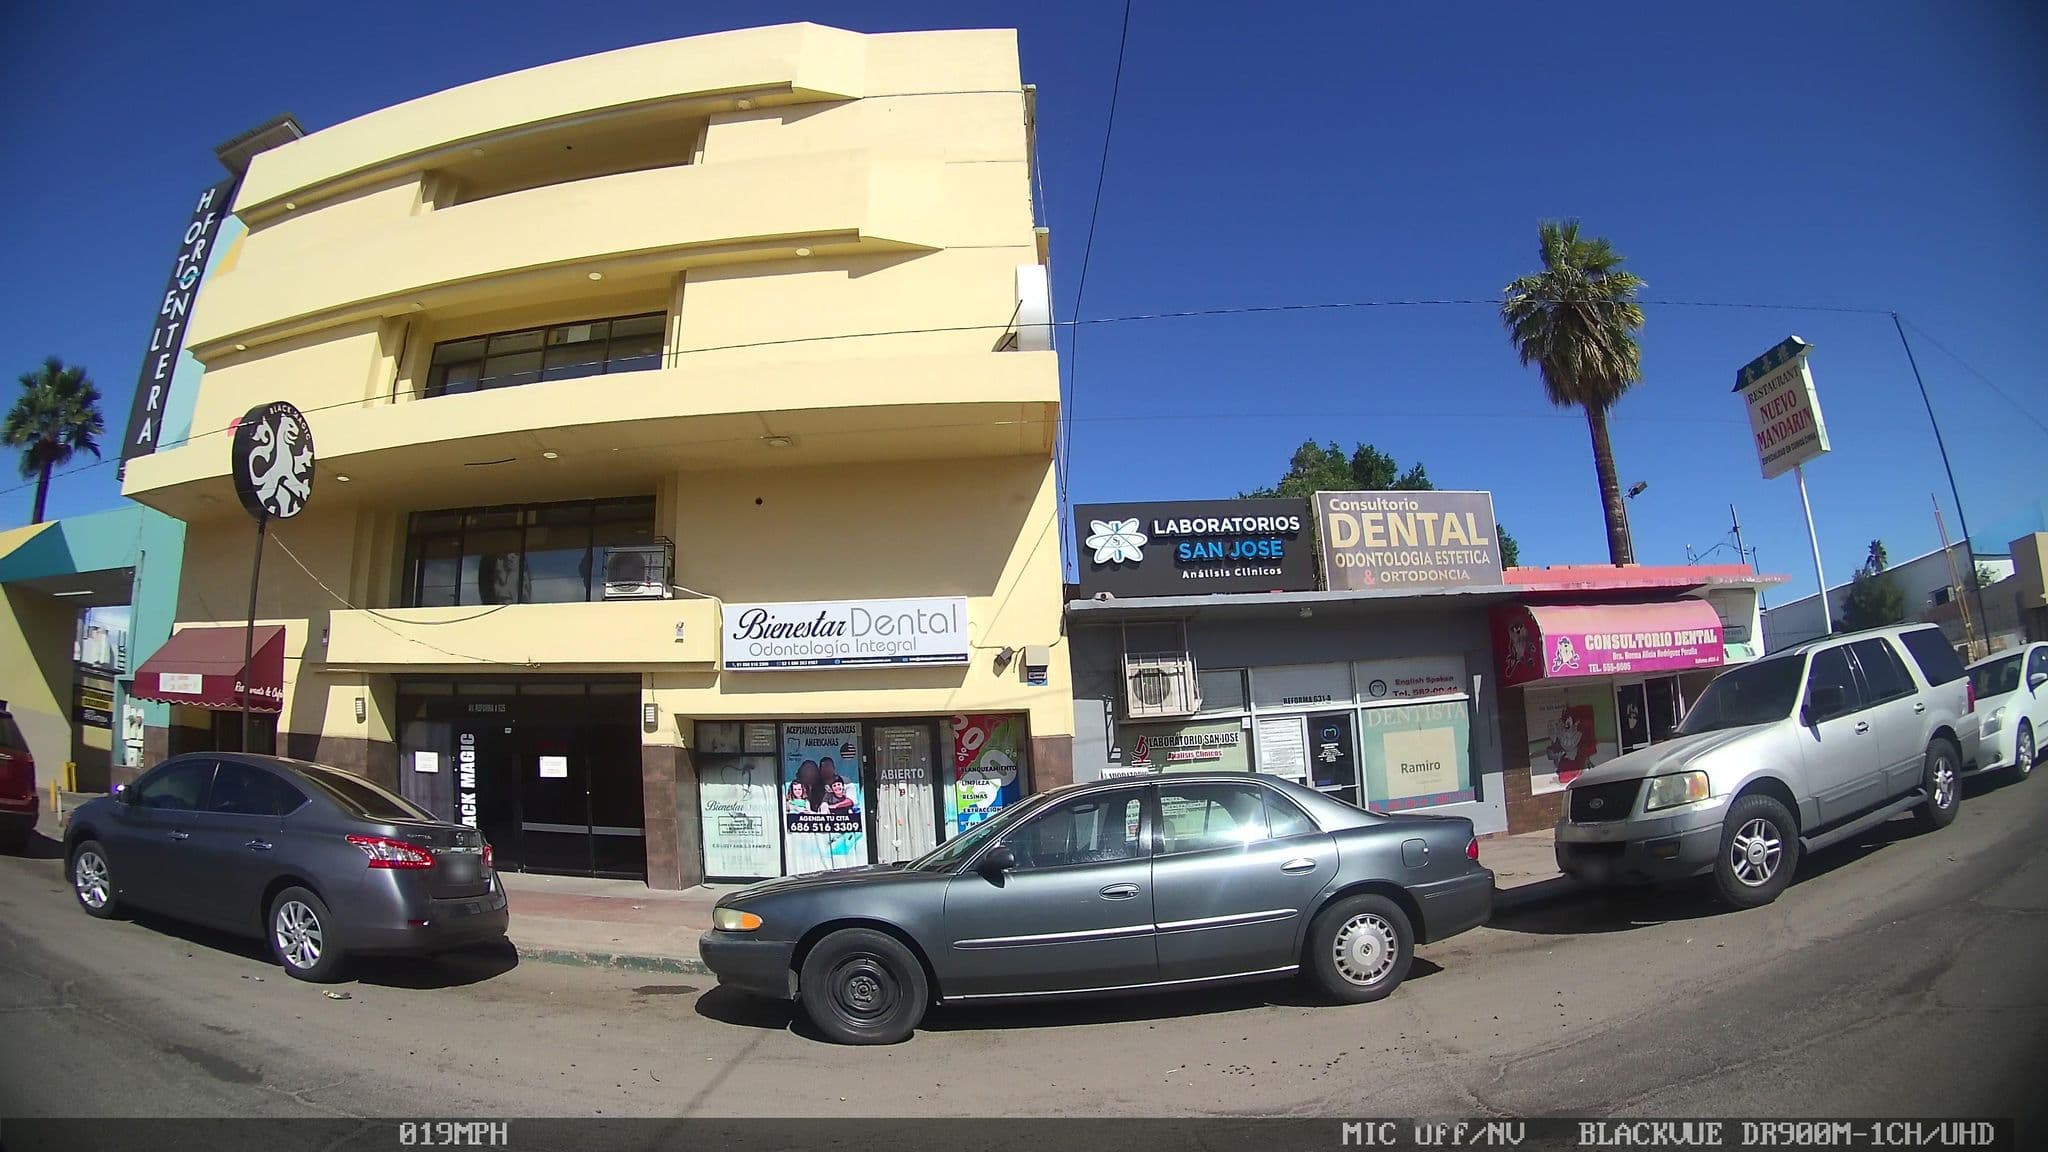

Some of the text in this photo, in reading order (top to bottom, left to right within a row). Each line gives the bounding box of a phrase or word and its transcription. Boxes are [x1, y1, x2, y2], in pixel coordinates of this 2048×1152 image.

[151, 189, 216, 352] HOTEL
[137, 212, 216, 445] FRONTERA
[1748, 367, 1800, 405] RESTAURANT
[1760, 389, 1797, 424] NUEVO
[1756, 407, 1813, 451] MANDARIN
[1329, 498, 1419, 511] Consultorio
[1154, 516, 1300, 535] LABORATORIOS
[1328, 512, 1489, 548] DENTAL
[1179, 542, 1223, 559] SAN
[1335, 550, 1491, 568] ODONTOLOGIA ESTETICA
[1363, 569, 1471, 585] & ORTODONCIA
[733, 603, 958, 640] Bienestar Dental
[749, 637, 917, 657] Odontología Integral
[1585, 628, 1718, 651] CONSULTORIO DENTAL
[1367, 703, 1467, 728] DENTISTA
[786, 724, 856, 735] ACEPTAMOS ASEGURANZAS
[805, 738, 839, 747] AMERICANAS
[1149, 734, 1203, 747] LABORATORIO
[1204, 732, 1219, 744] SAN
[881, 768, 924, 780] ABIERTO
[960, 765, 1017, 773] BLANQUEAMIENTO
[1401, 760, 1441, 774] Ramiro
[460, 733, 476, 829] ACK MAGIC
[790, 822, 859, 831] 686 516 3309
